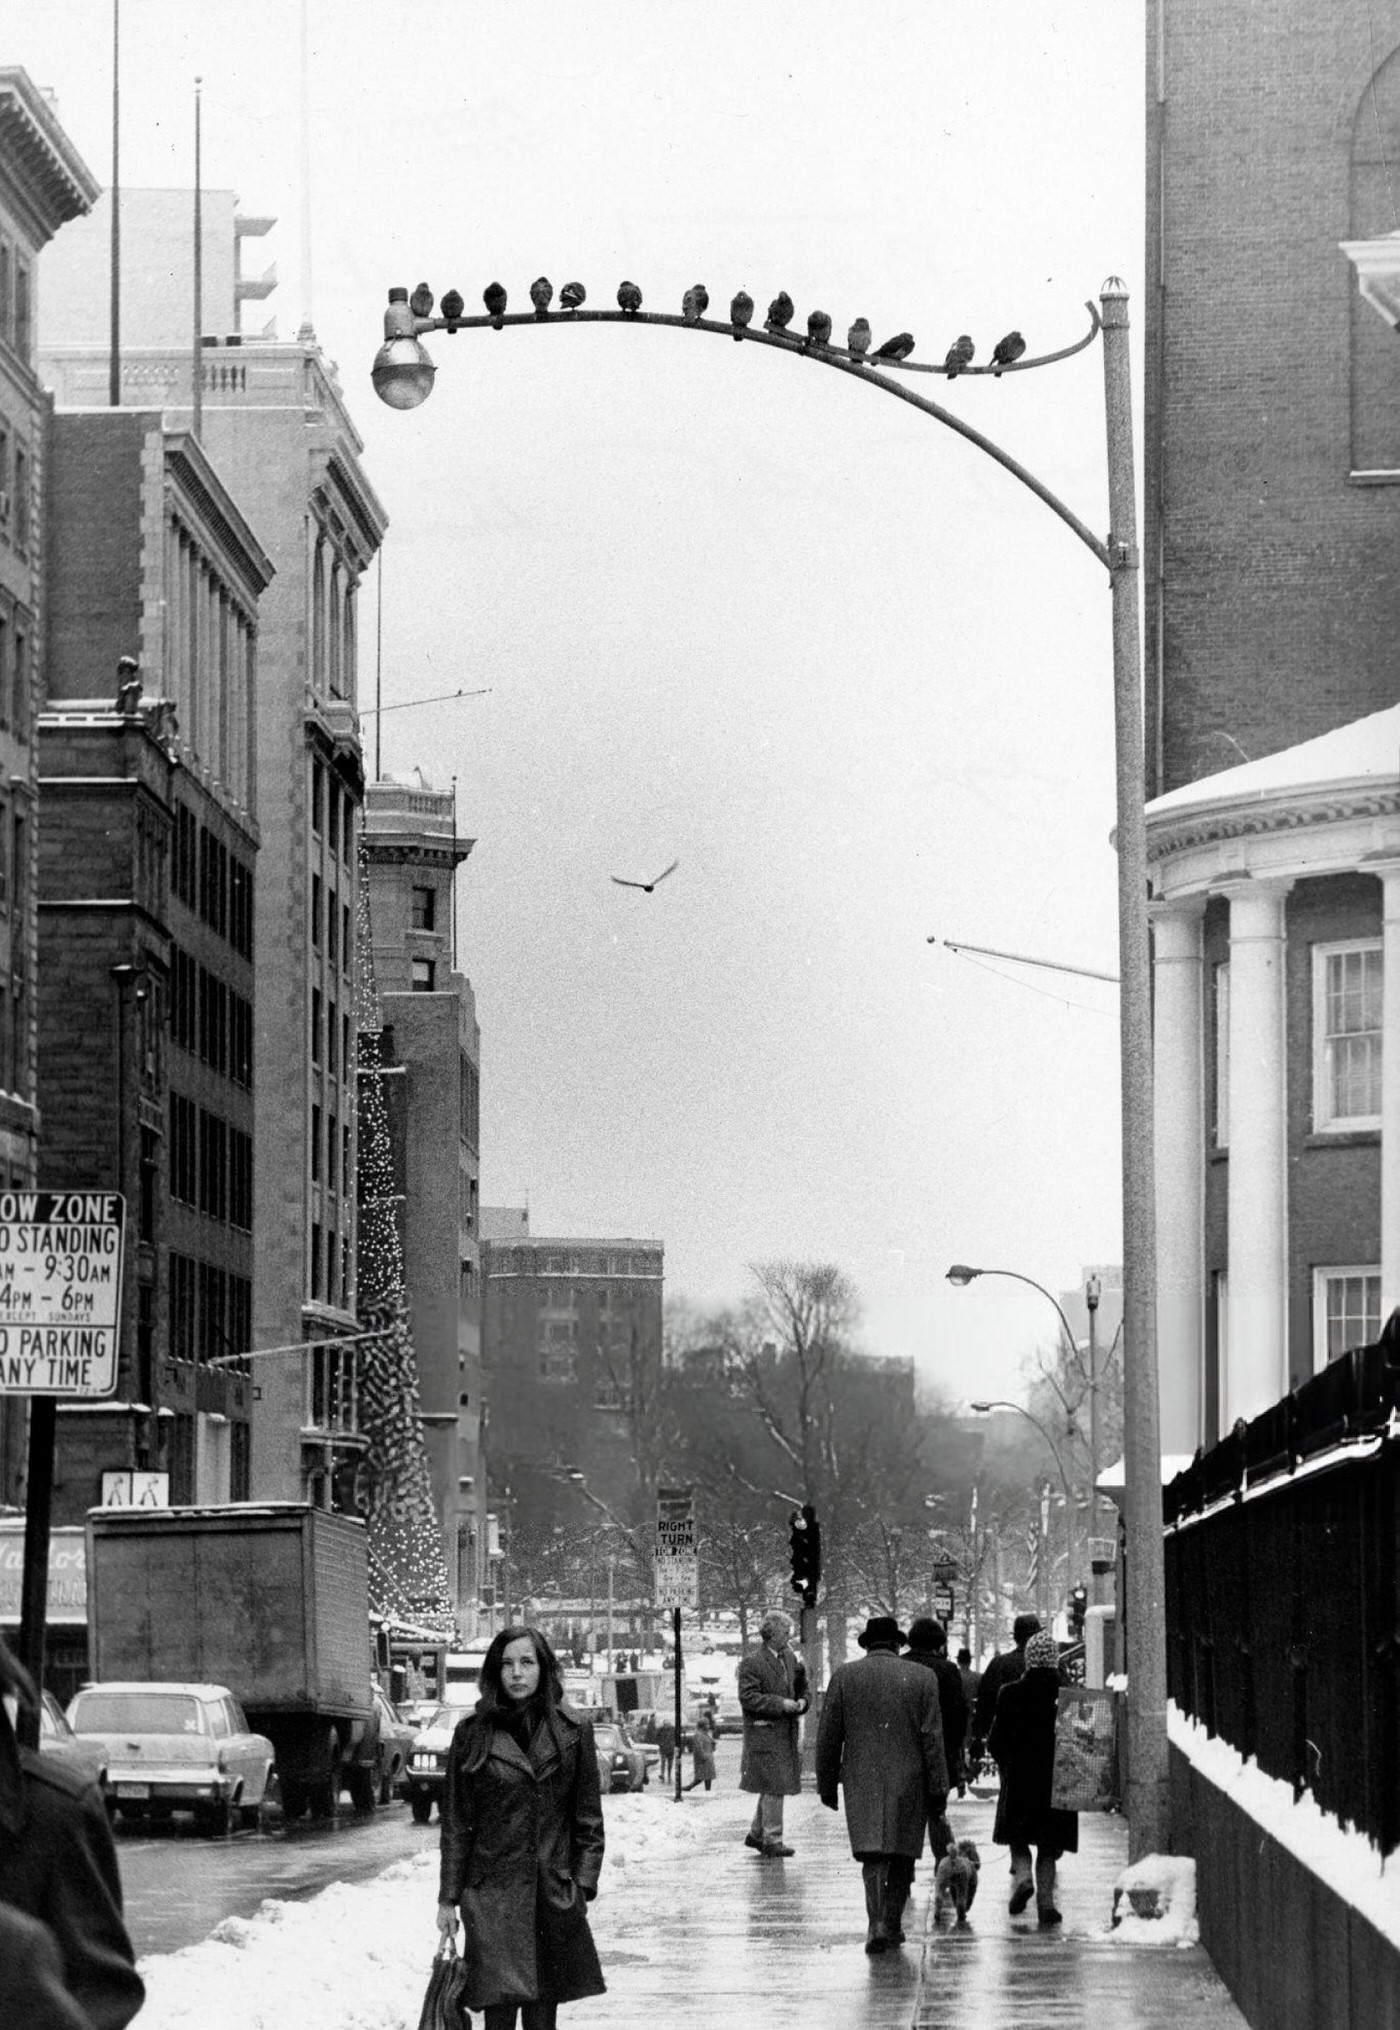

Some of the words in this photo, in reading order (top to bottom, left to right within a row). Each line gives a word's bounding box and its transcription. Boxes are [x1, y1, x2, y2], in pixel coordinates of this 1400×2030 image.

[50, 1195, 117, 1223] ZONE
[17, 1226, 115, 1254] STANDING
[45, 1255, 110, 1283] 9:30AM
[0, 1283, 32, 1310] 4PM
[62, 1284, 94, 1311] 6PM
[49, 1312, 90, 1322] SUNDAYS
[20, 1330, 106, 1358] PARKING
[48, 1359, 92, 1386] TIME
[658, 1521, 694, 1532] RIGHT
[661, 1533, 693, 1545] TURN
